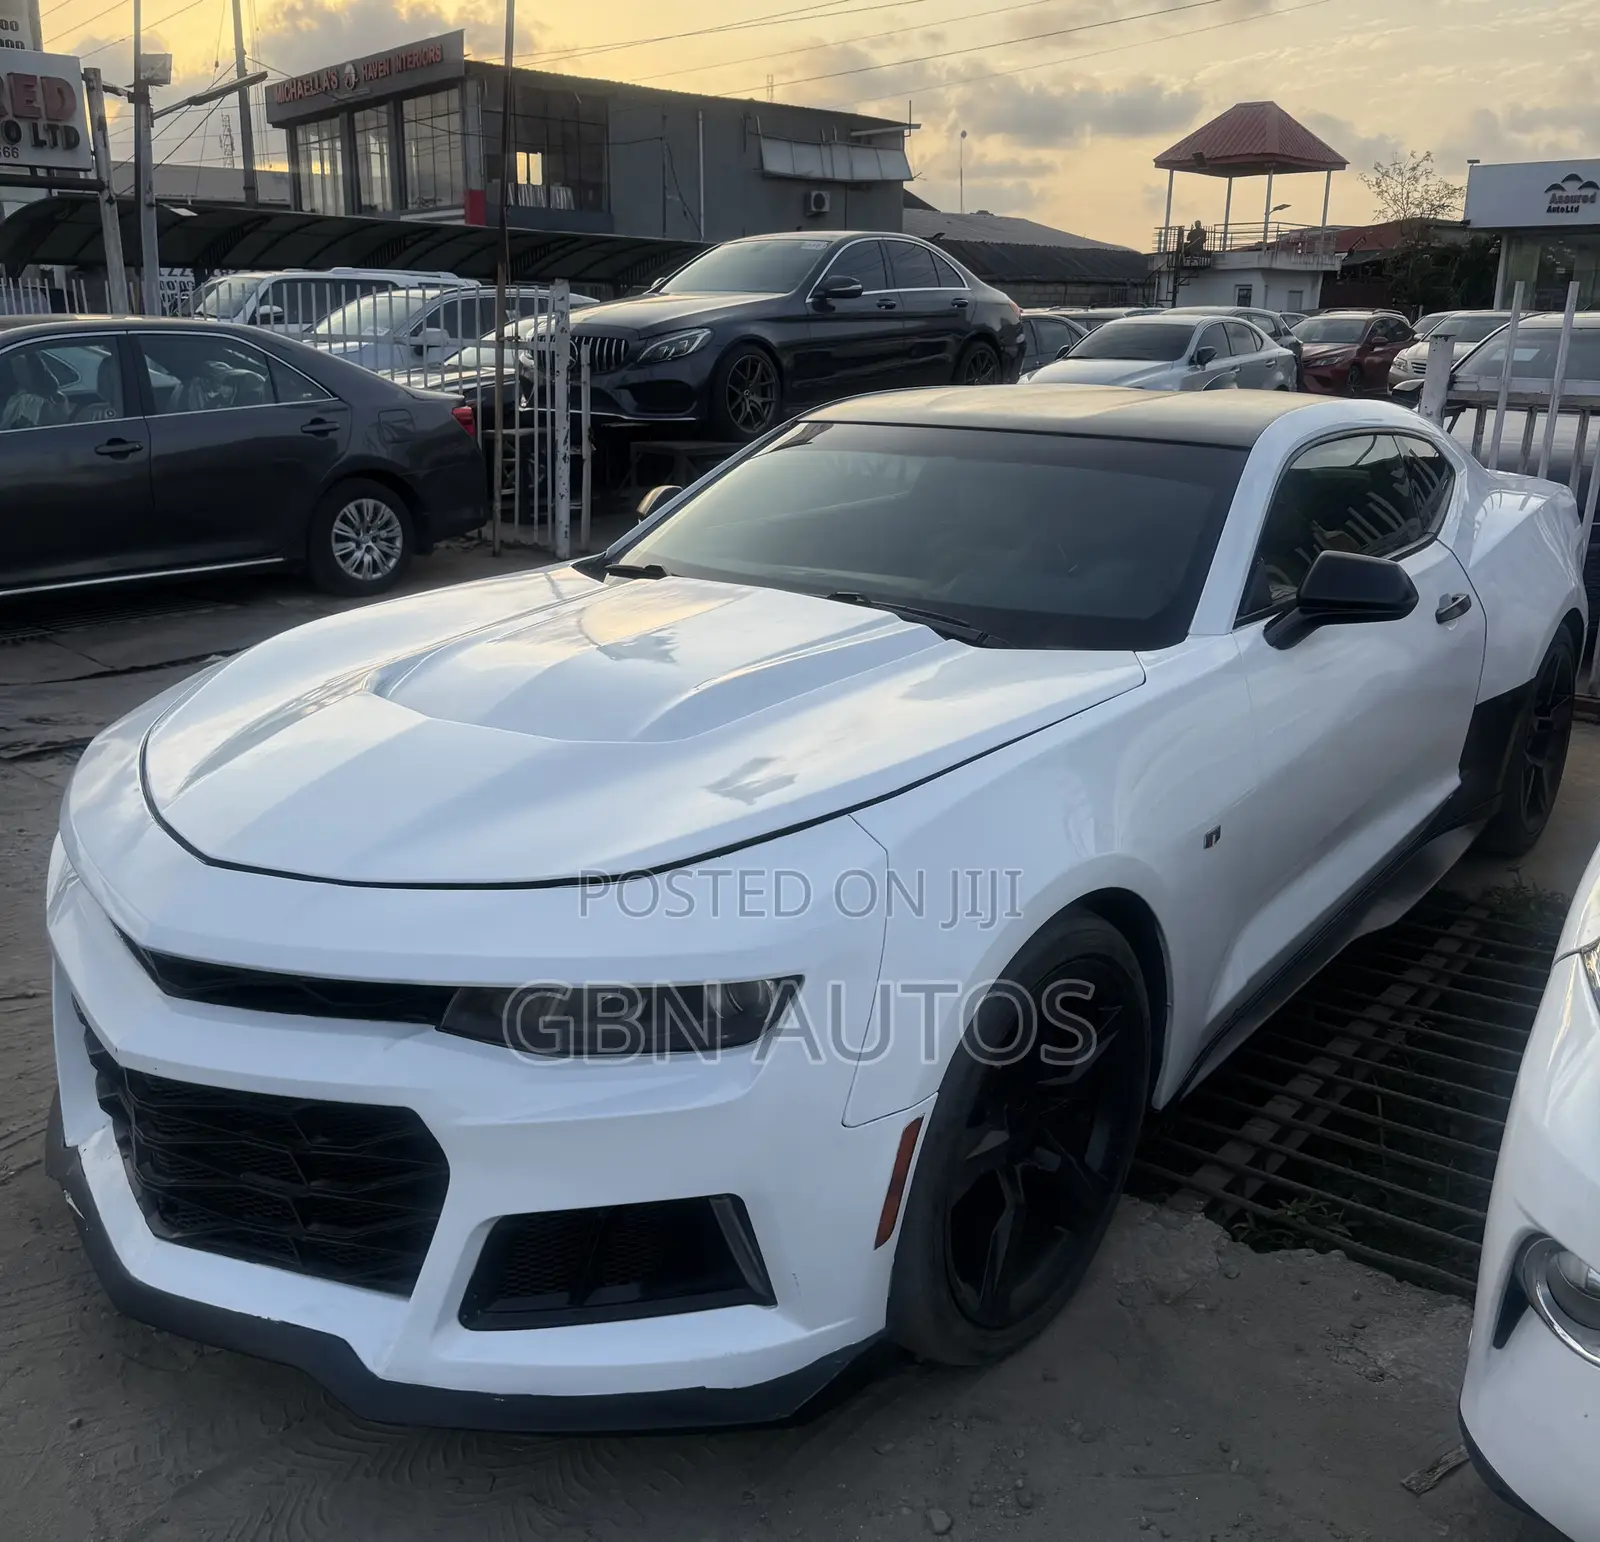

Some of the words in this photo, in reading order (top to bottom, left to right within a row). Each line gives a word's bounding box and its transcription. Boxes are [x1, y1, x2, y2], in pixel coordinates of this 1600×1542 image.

[275, 69, 340, 105] MICHAELLA'S
[361, 59, 391, 82] HAVEN
[394, 44, 444, 74] INTERIORS
[0, 71, 77, 122] ED
[29, 121, 80, 150] LTD
[1546, 205, 1565, 213] Auto
[1565, 204, 1580, 213] Ltd
